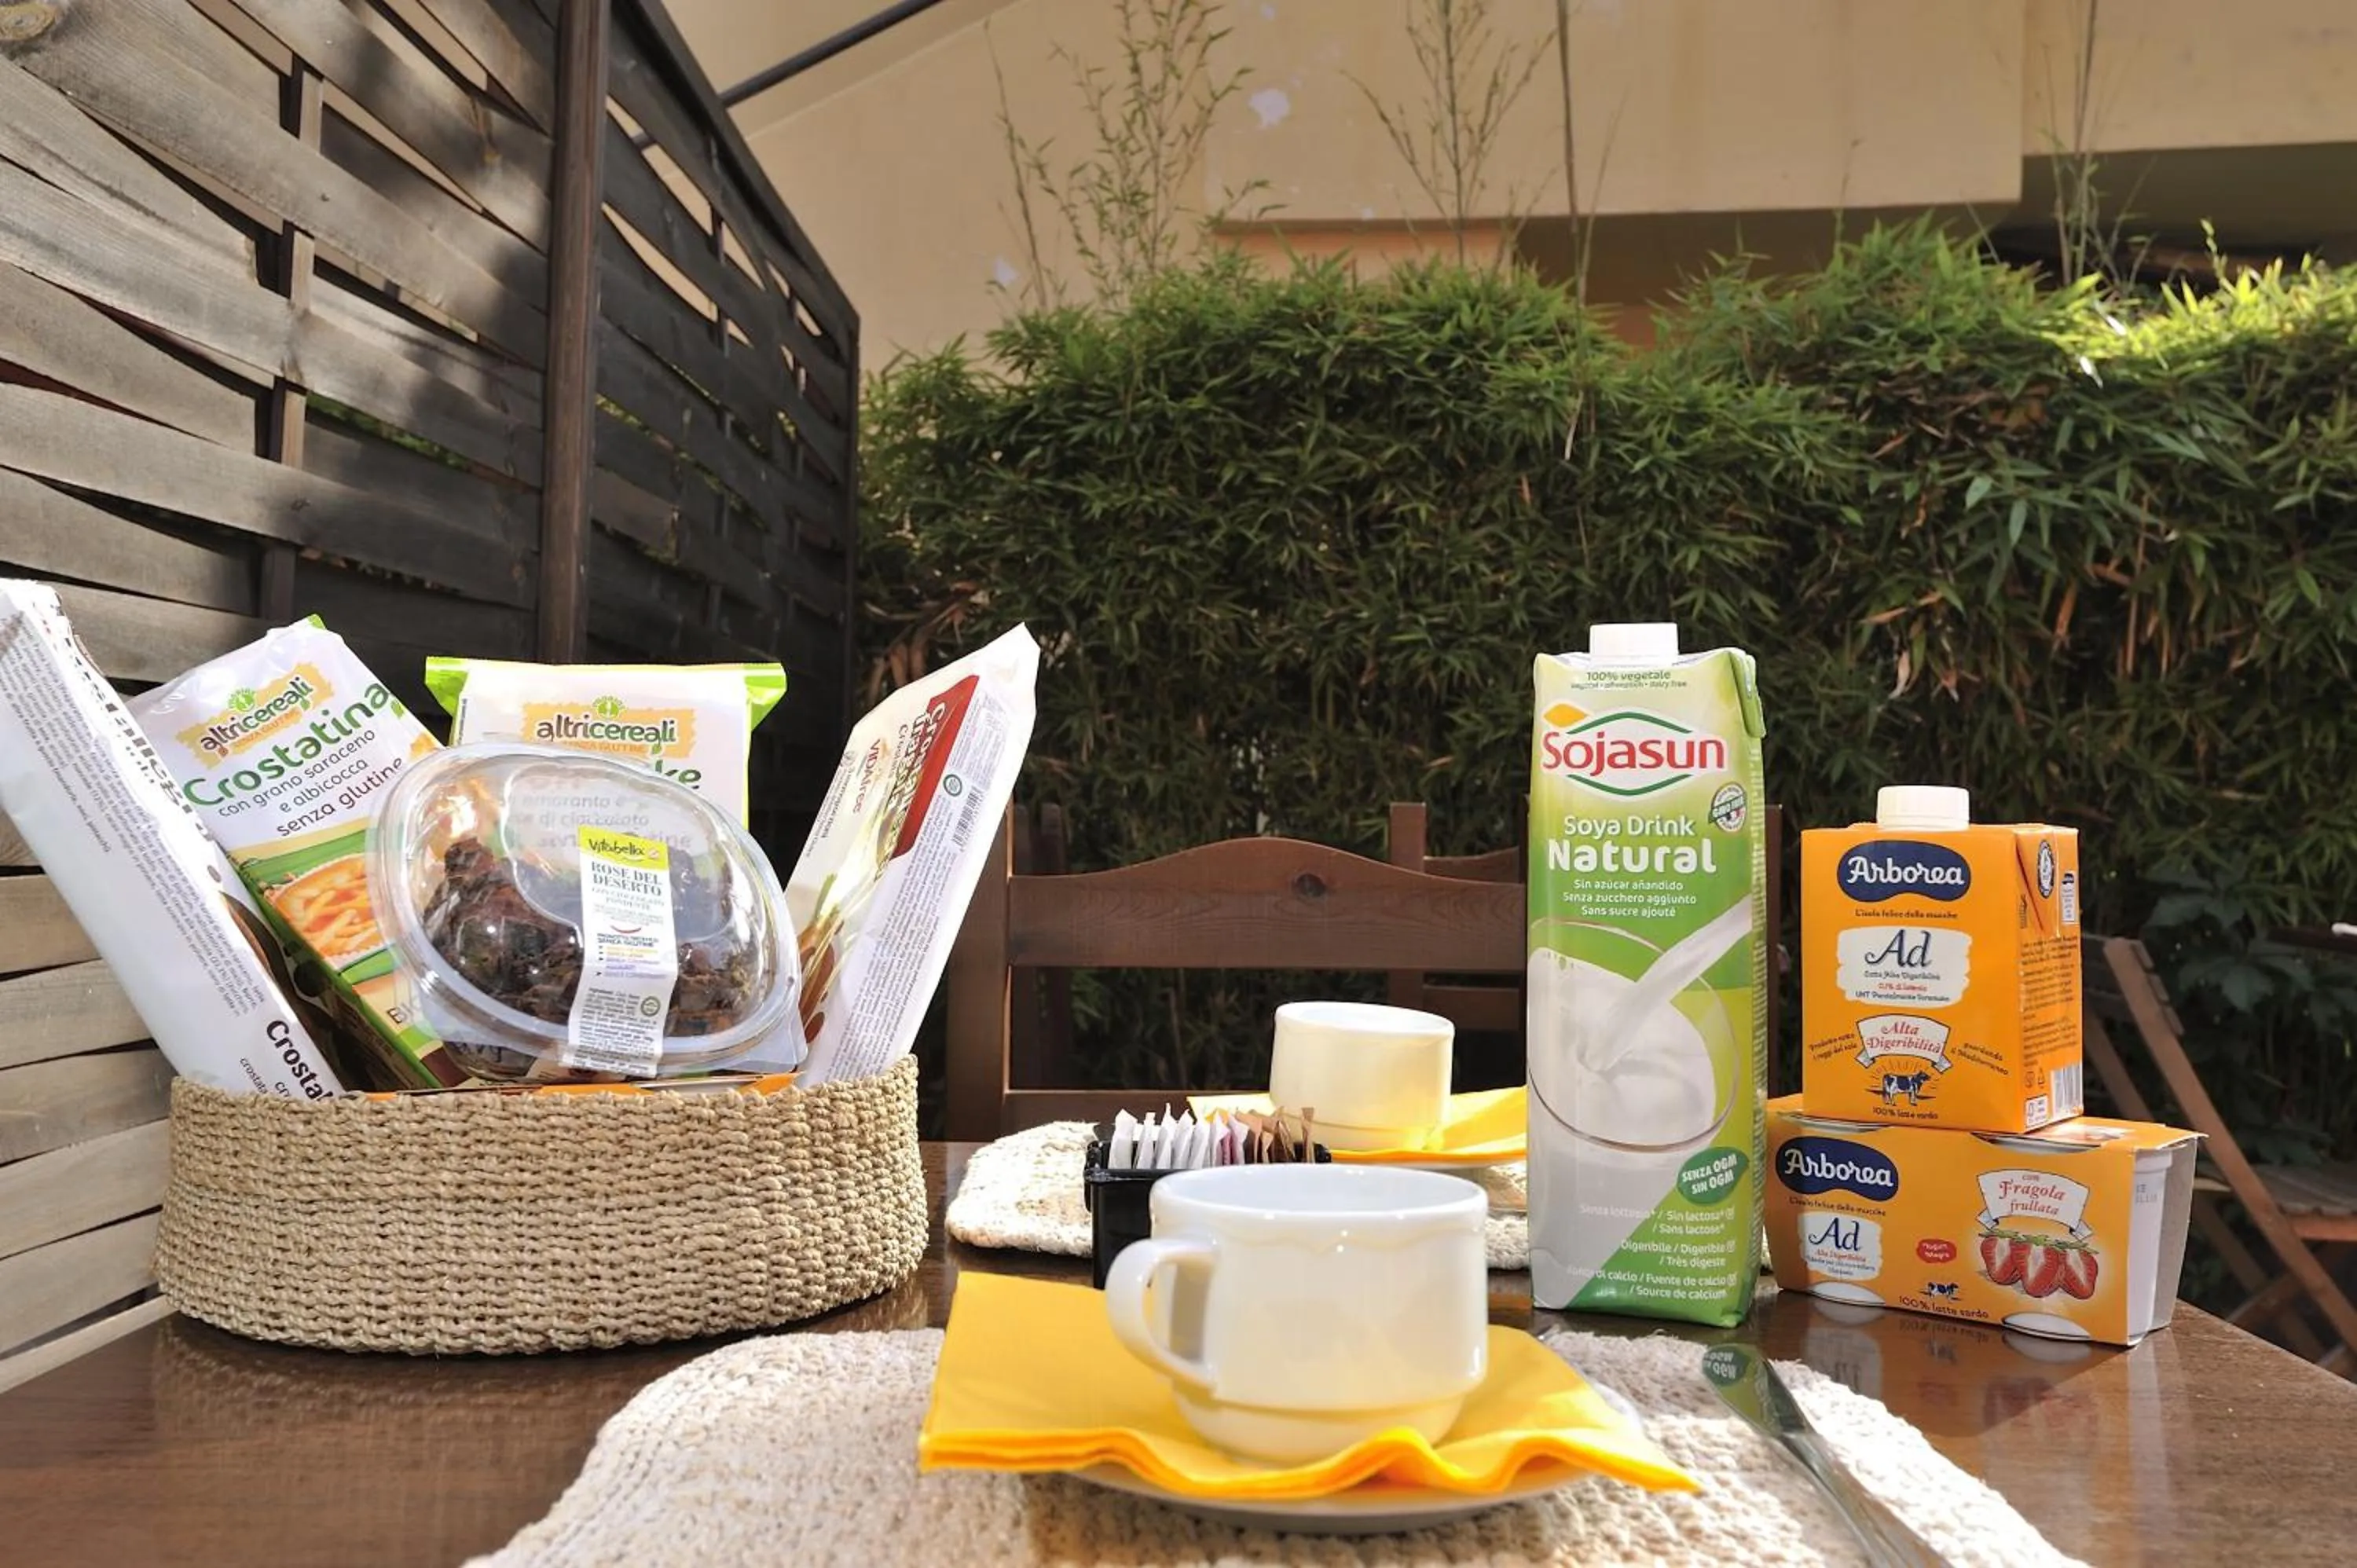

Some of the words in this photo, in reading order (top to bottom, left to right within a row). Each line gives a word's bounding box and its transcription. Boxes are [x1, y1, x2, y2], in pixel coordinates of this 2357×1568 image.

[1586, 671, 1619, 680] 100%
[1621, 670, 1671, 682] vegetale
[200, 676, 313, 752] altricereali
[537, 714, 676, 744] altricereali
[182, 682, 389, 806] Crostatina
[1541, 730, 1725, 776] Sojasun
[218, 798, 250, 817] con
[255, 775, 302, 807] grano
[304, 730, 376, 778] saraceno
[280, 801, 291, 813] e
[295, 757, 368, 807] albicocca
[277, 801, 335, 837] senza
[338, 757, 403, 809] glutine
[1564, 815, 1622, 839] Soya
[1627, 815, 1695, 836] Drink
[1548, 838, 1717, 874] Natural
[1846, 855, 1966, 885] Arborea
[593, 874, 662, 896] DESERTO
[1574, 879, 1591, 888] Sin
[1595, 878, 1629, 889] azúcar
[1563, 892, 1593, 902] Senza
[1596, 892, 1644, 903] zucchero
[1647, 893, 1697, 906] aggiunto
[1582, 905, 1607, 916] Sans
[1609, 907, 1638, 916] sucre
[1641, 906, 1676, 918] ajouté
[1864, 929, 1934, 968] Ad
[1881, 1021, 1919, 1035] Alta
[1867, 1036, 1941, 1053] Digeribilità
[1682, 1163, 1711, 1181] SENZA
[1713, 1154, 1738, 1172] OGM
[1784, 1148, 1895, 1188] Arborea
[1692, 1181, 1707, 1195] SIN
[1709, 1171, 1735, 1188] OGM
[1999, 1179, 2066, 1201] Fragola
[2011, 1200, 2059, 1216] frullata
[1808, 1217, 1863, 1251] Ad
[1637, 1284, 1672, 1297] Source
[1646, 1273, 1681, 1285] Fuente
[1898, 1295, 1930, 1311] 100%
